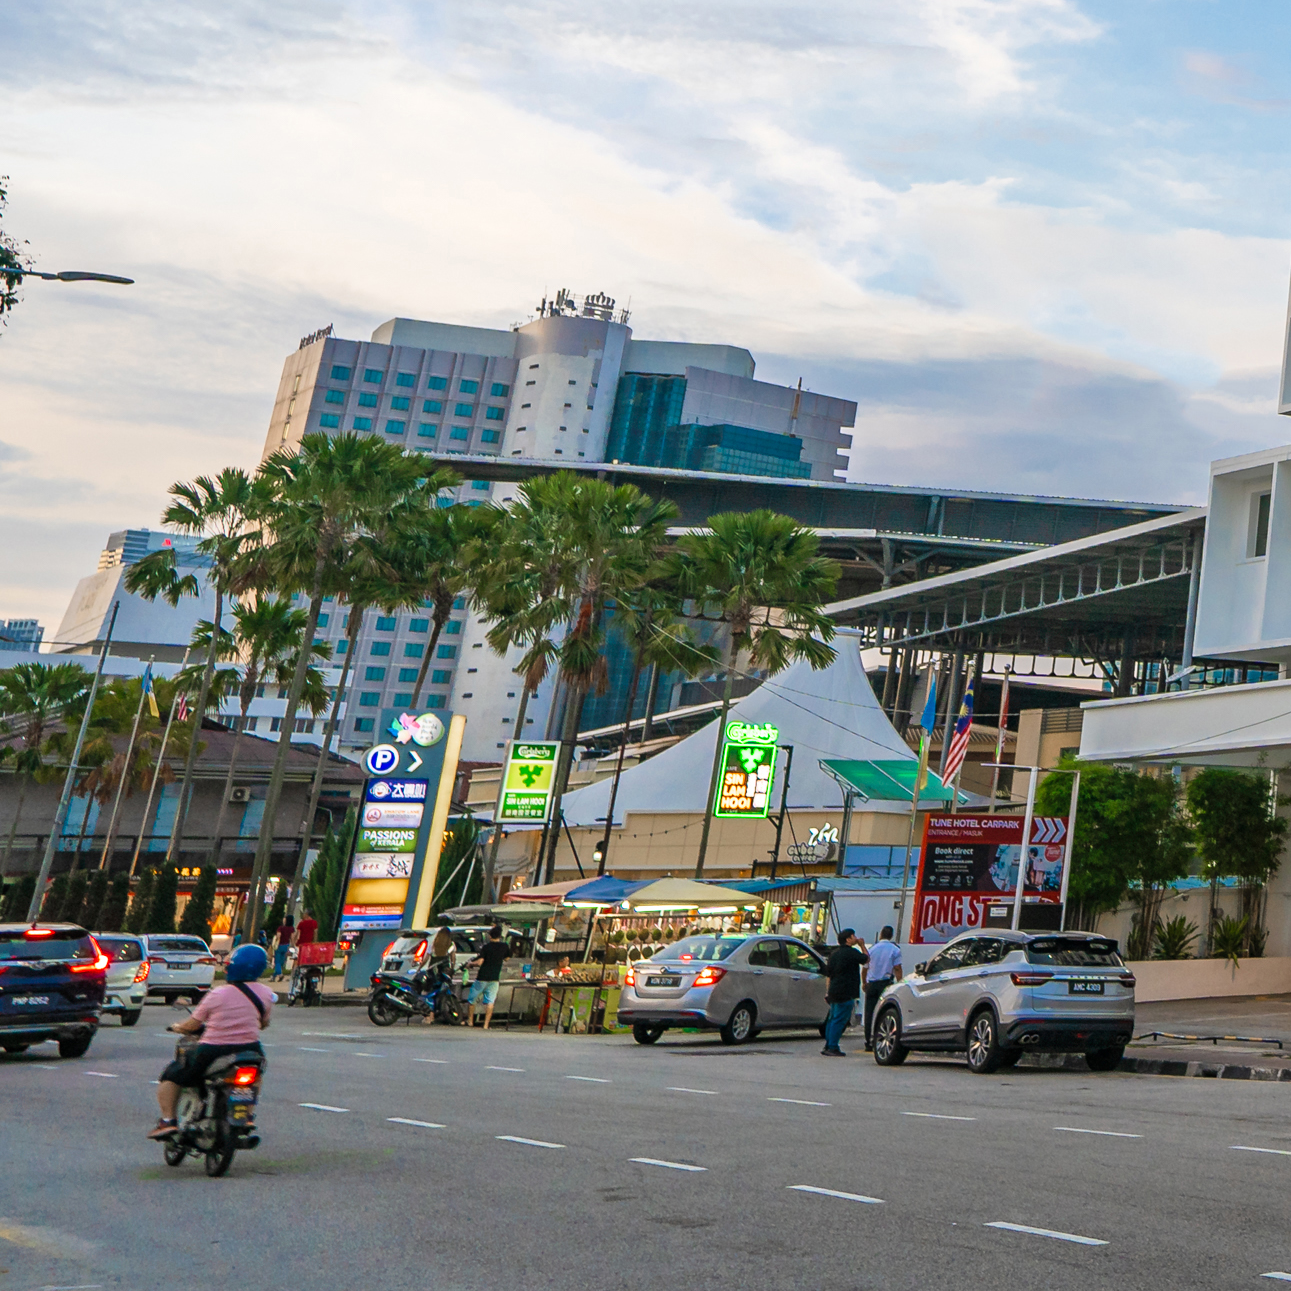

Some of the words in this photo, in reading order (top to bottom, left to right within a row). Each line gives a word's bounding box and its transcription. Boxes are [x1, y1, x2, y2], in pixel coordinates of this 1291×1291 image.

[518, 745, 551, 758] Carlsberg
[725, 772, 745, 785] SIN
[723, 785, 746, 797] LAM
[721, 797, 752, 809] HOOI
[930, 818, 953, 827] TUNE
[953, 819, 980, 828] HOTEL
[981, 820, 1020, 829] CARPARK
[363, 830, 415, 840] PASSIONS
[377, 839, 406, 847] KERALA
[935, 846, 952, 855] Book
[953, 847, 974, 855] direct
